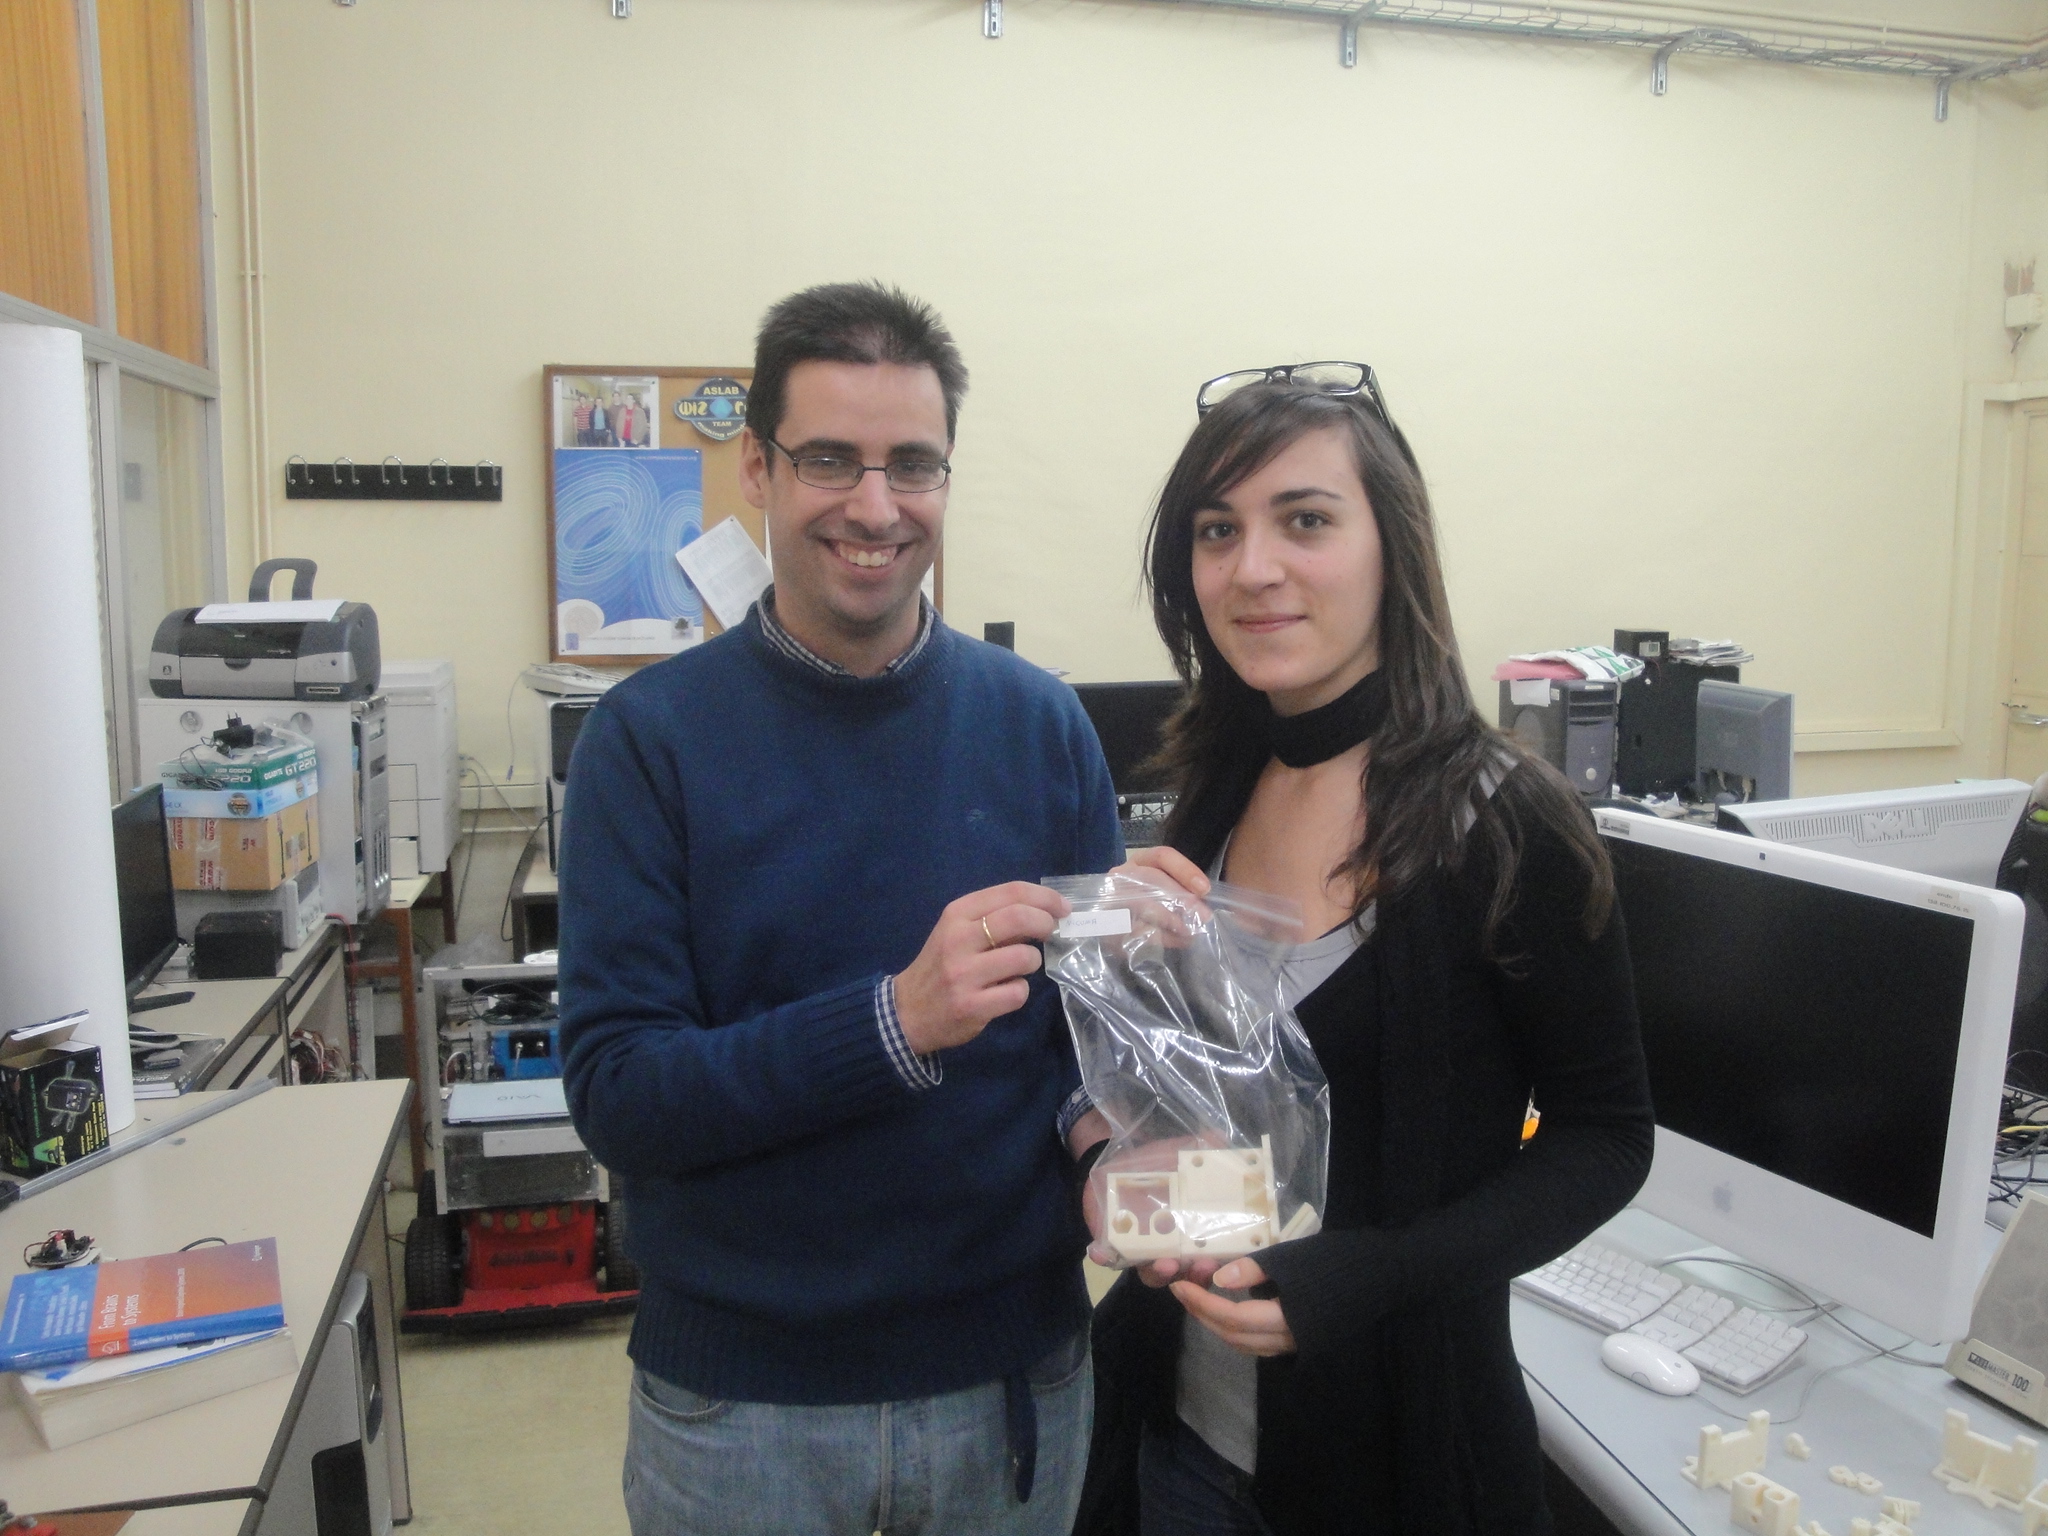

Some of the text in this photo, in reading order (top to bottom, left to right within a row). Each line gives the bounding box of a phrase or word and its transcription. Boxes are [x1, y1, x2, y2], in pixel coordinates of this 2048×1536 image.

[703, 386, 740, 396] ASLAB
[284, 761, 298, 777] GT
[298, 756, 317, 771] 220
[98, 1294, 119, 1330] From Brains
[120, 1294, 142, 1326] to Systems
[2011, 1373, 2030, 1392] 100
